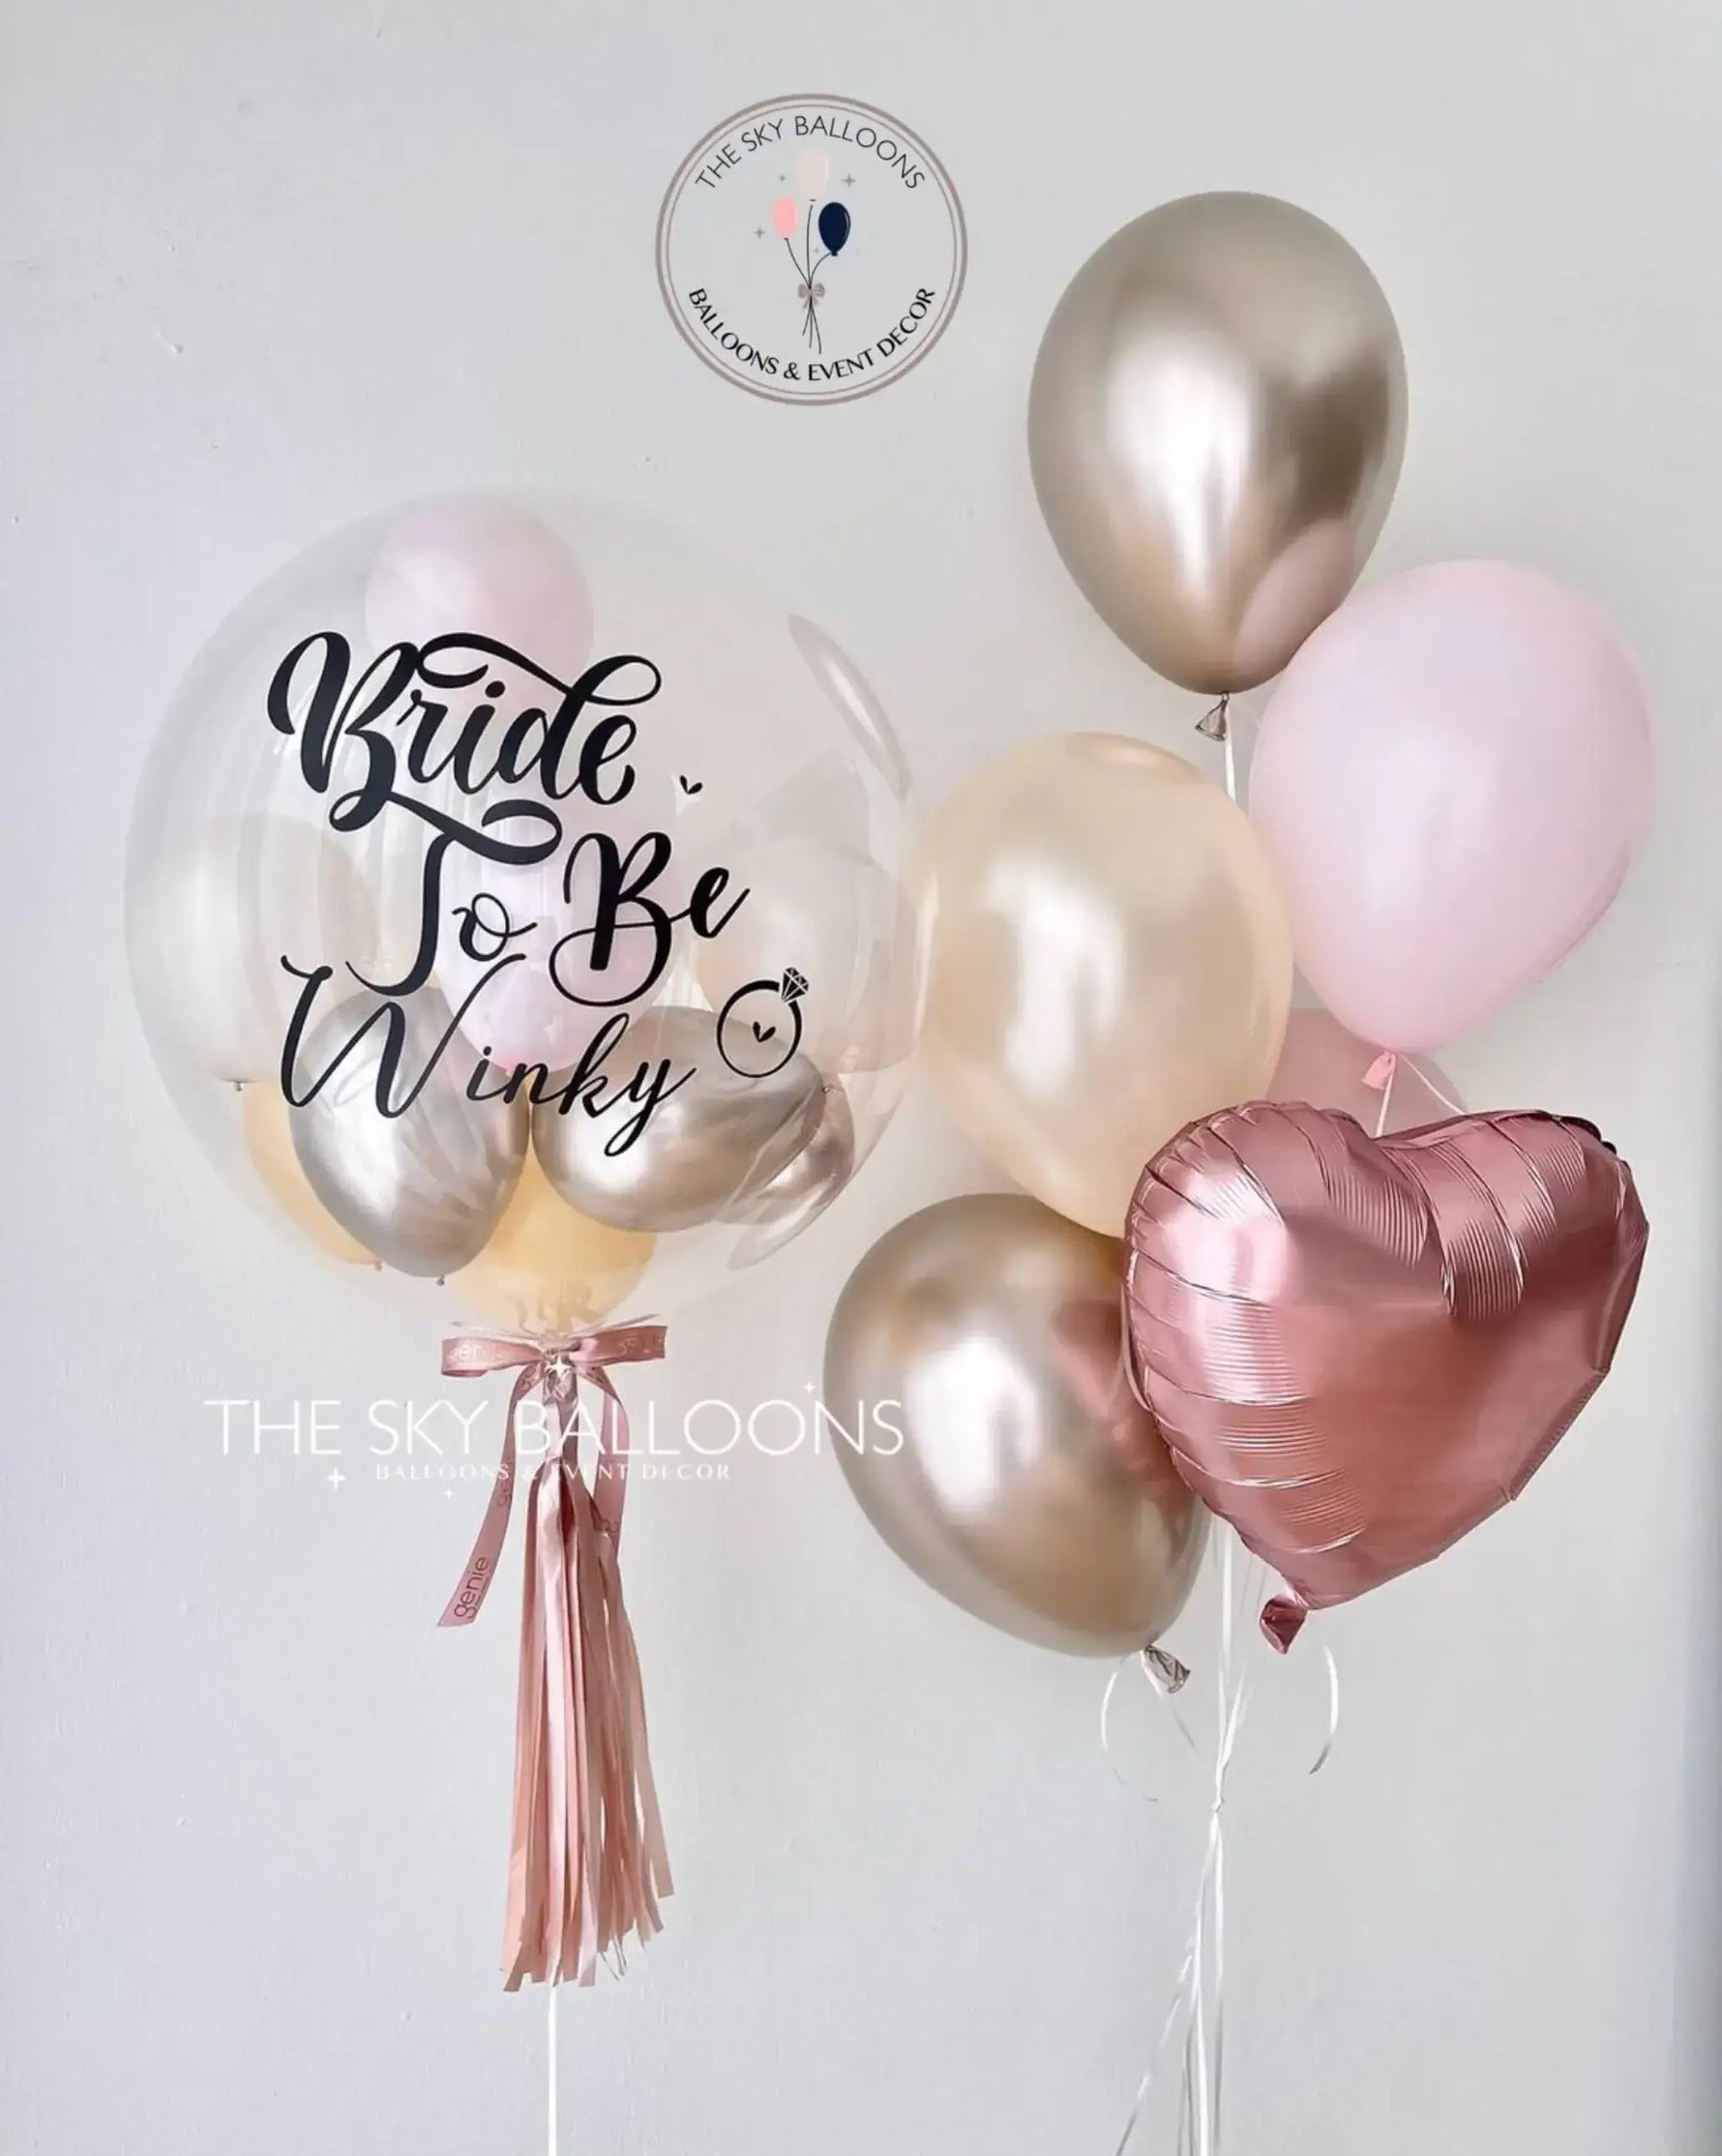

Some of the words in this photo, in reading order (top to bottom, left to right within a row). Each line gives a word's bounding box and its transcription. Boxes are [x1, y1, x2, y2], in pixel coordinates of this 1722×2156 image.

[267, 631, 662, 832] Bride
[345, 799, 563, 997] To
[549, 831, 750, 1007] Be
[281, 952, 697, 1156] Winky
[454, 1556, 490, 1620] genie
